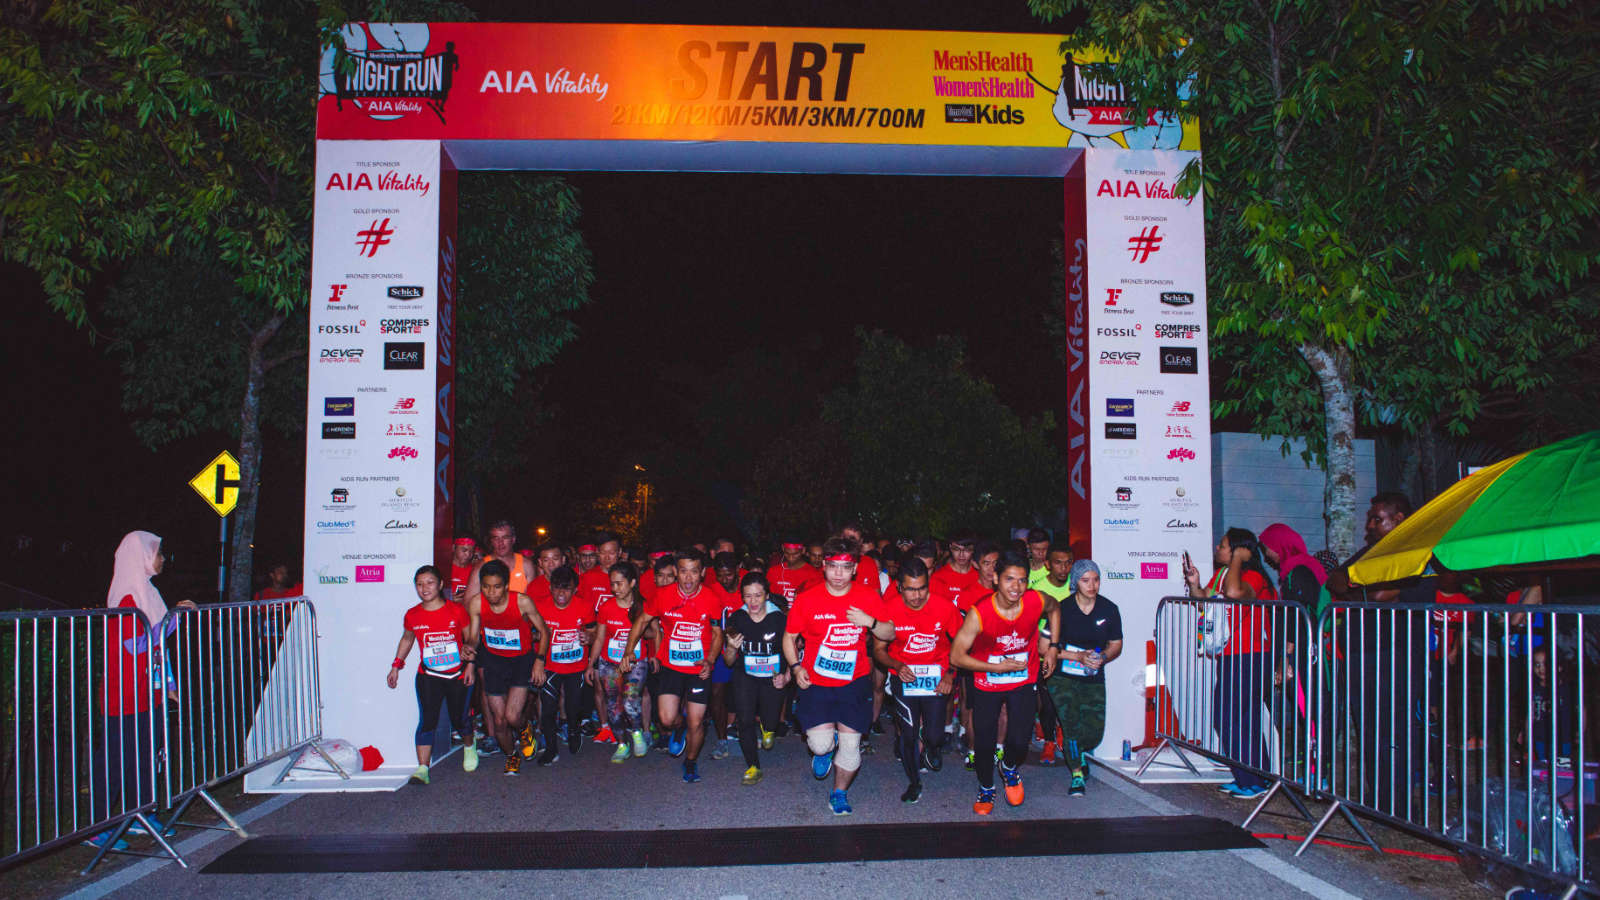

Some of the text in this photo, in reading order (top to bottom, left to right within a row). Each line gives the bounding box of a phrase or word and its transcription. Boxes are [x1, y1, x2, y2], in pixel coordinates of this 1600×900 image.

[346, 55, 443, 91] NIGHT RUN
[672, 40, 865, 102] START
[480, 68, 608, 101] AIA Vitality
[369, 100, 422, 114] AIA Vitality
[977, 104, 1025, 125] Kids
[1099, 111, 1122, 121] AIA
[326, 170, 430, 197] AIA Vitality
[1097, 179, 1141, 198] AIA
[391, 288, 421, 297] Schick
[1163, 294, 1190, 303] Schick
[380, 319, 429, 327] COMPRES
[1155, 324, 1200, 332] COMPRES
[318, 325, 360, 333] FOSSIL
[380, 326, 414, 334] SPORT
[1097, 328, 1136, 337] FOSSIL
[1067, 238, 1087, 500] AIA Vitality
[437, 381, 451, 502] AIA
[385, 520, 418, 529] Clarks
[1167, 519, 1198, 528] Clarks
[360, 567, 380, 576] Atria
[1145, 565, 1164, 573] Atria
[672, 650, 702, 660] E4030
[818, 656, 853, 672] E5902
